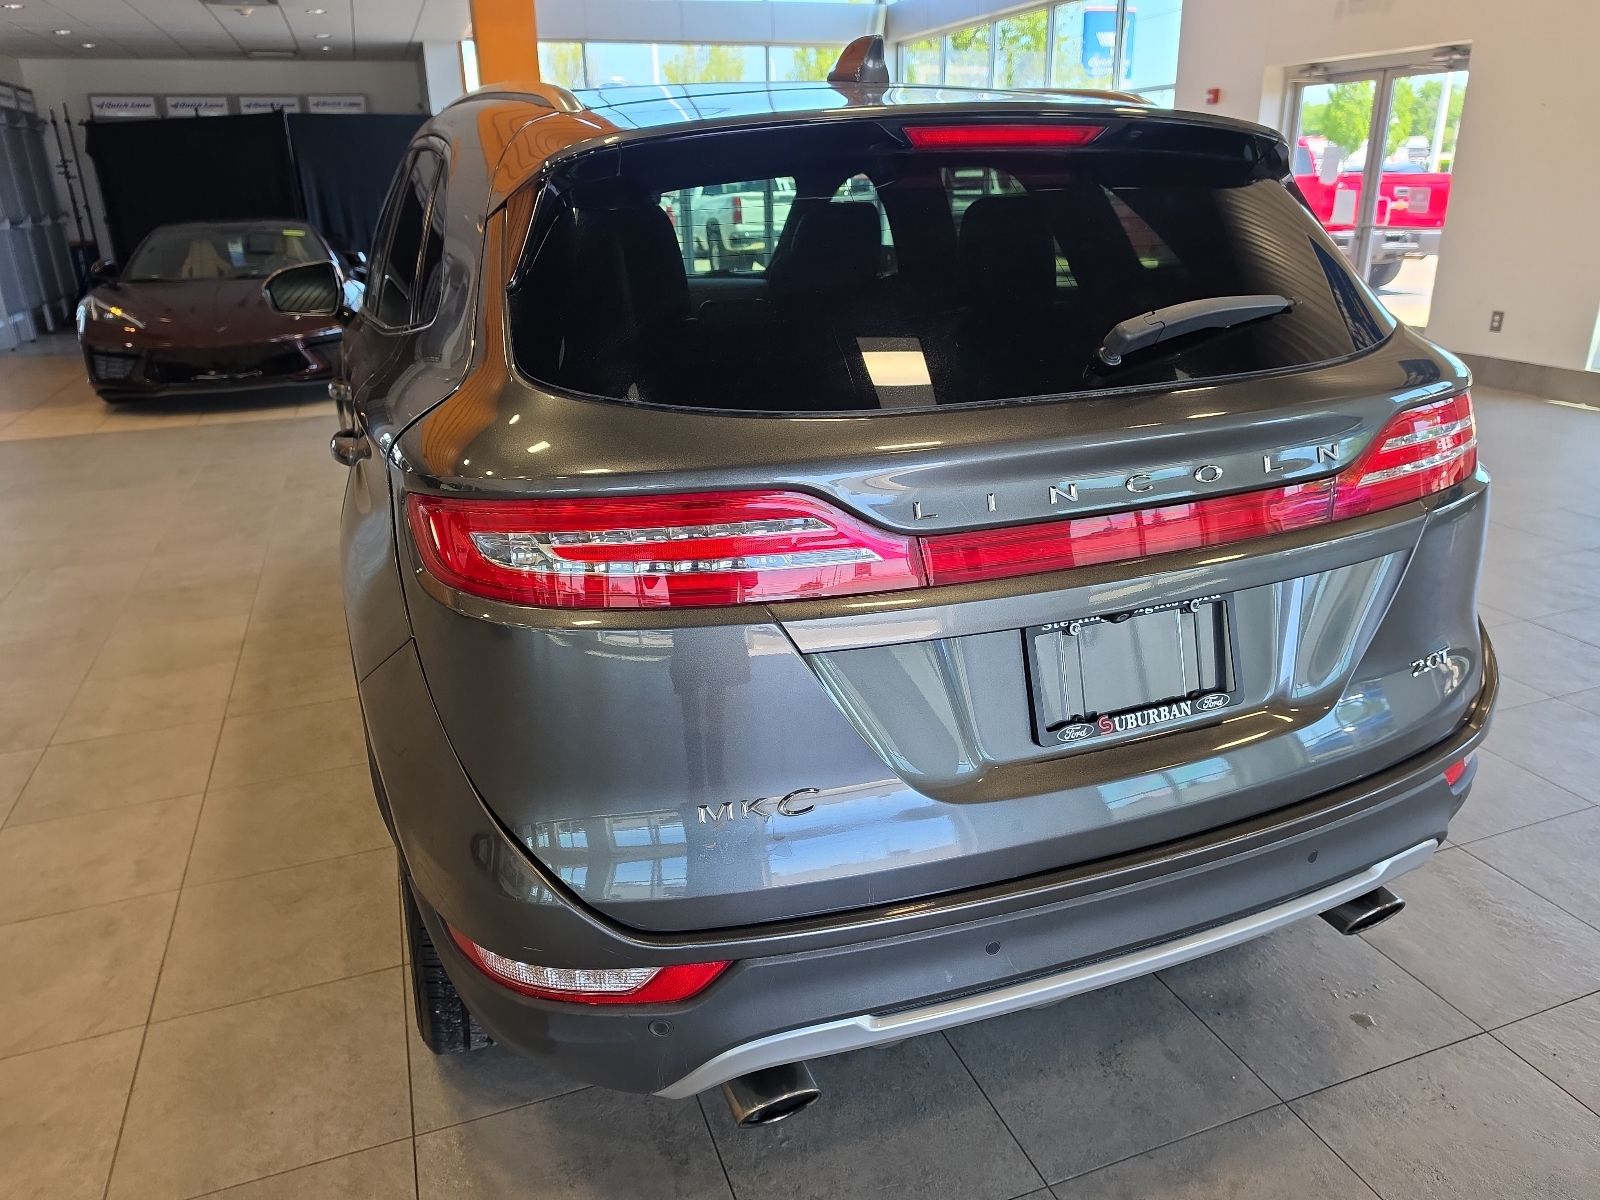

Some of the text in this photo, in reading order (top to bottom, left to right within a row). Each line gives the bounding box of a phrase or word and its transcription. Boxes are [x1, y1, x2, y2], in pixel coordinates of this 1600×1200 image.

[912, 443, 1340, 521] LINCOLN
[1064, 695, 1224, 740] Ford SUBURBAN Ford
[697, 787, 820, 823] MKC
